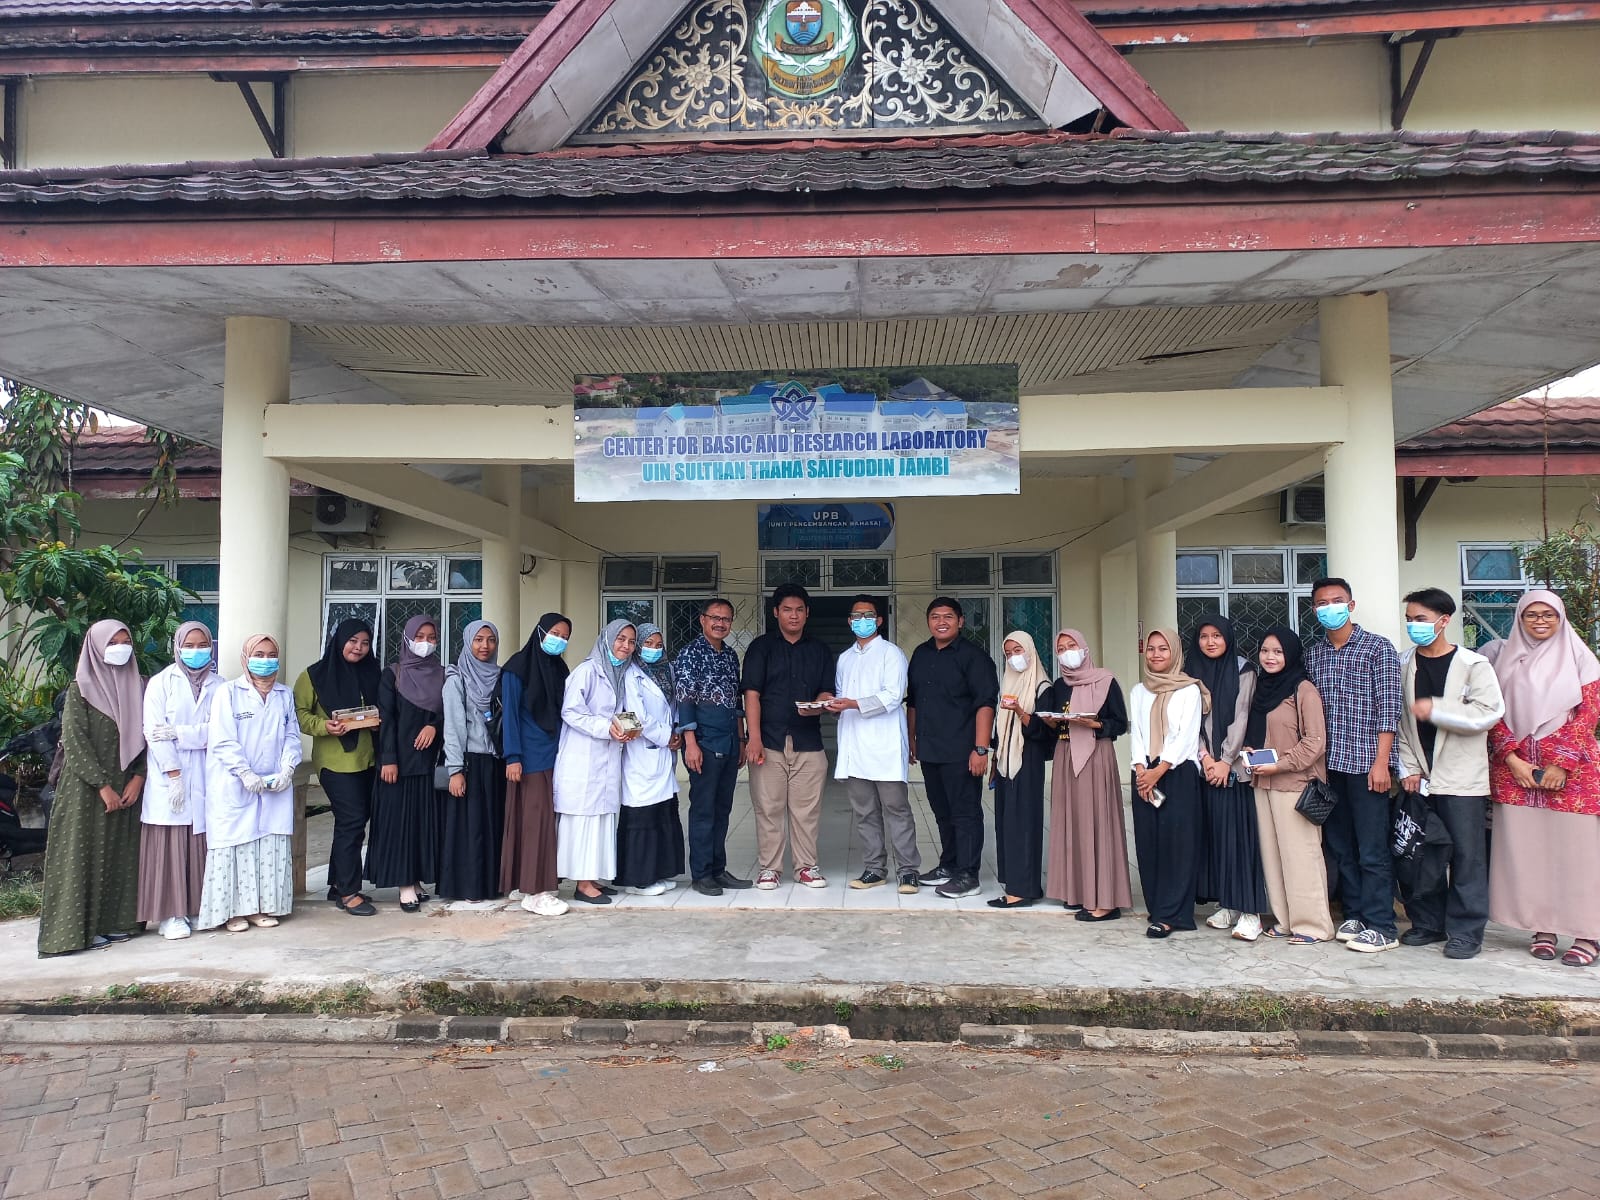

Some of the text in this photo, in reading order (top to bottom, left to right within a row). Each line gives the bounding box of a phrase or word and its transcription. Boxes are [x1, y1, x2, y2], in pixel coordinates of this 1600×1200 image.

[603, 430, 988, 457] CENTER FOR BASIC AND RESEARCH LABORATORY
[642, 456, 949, 481] UIN SULTHAN THAHA SAIFUDDIN JAMBI
[813, 511, 839, 520] UPB
